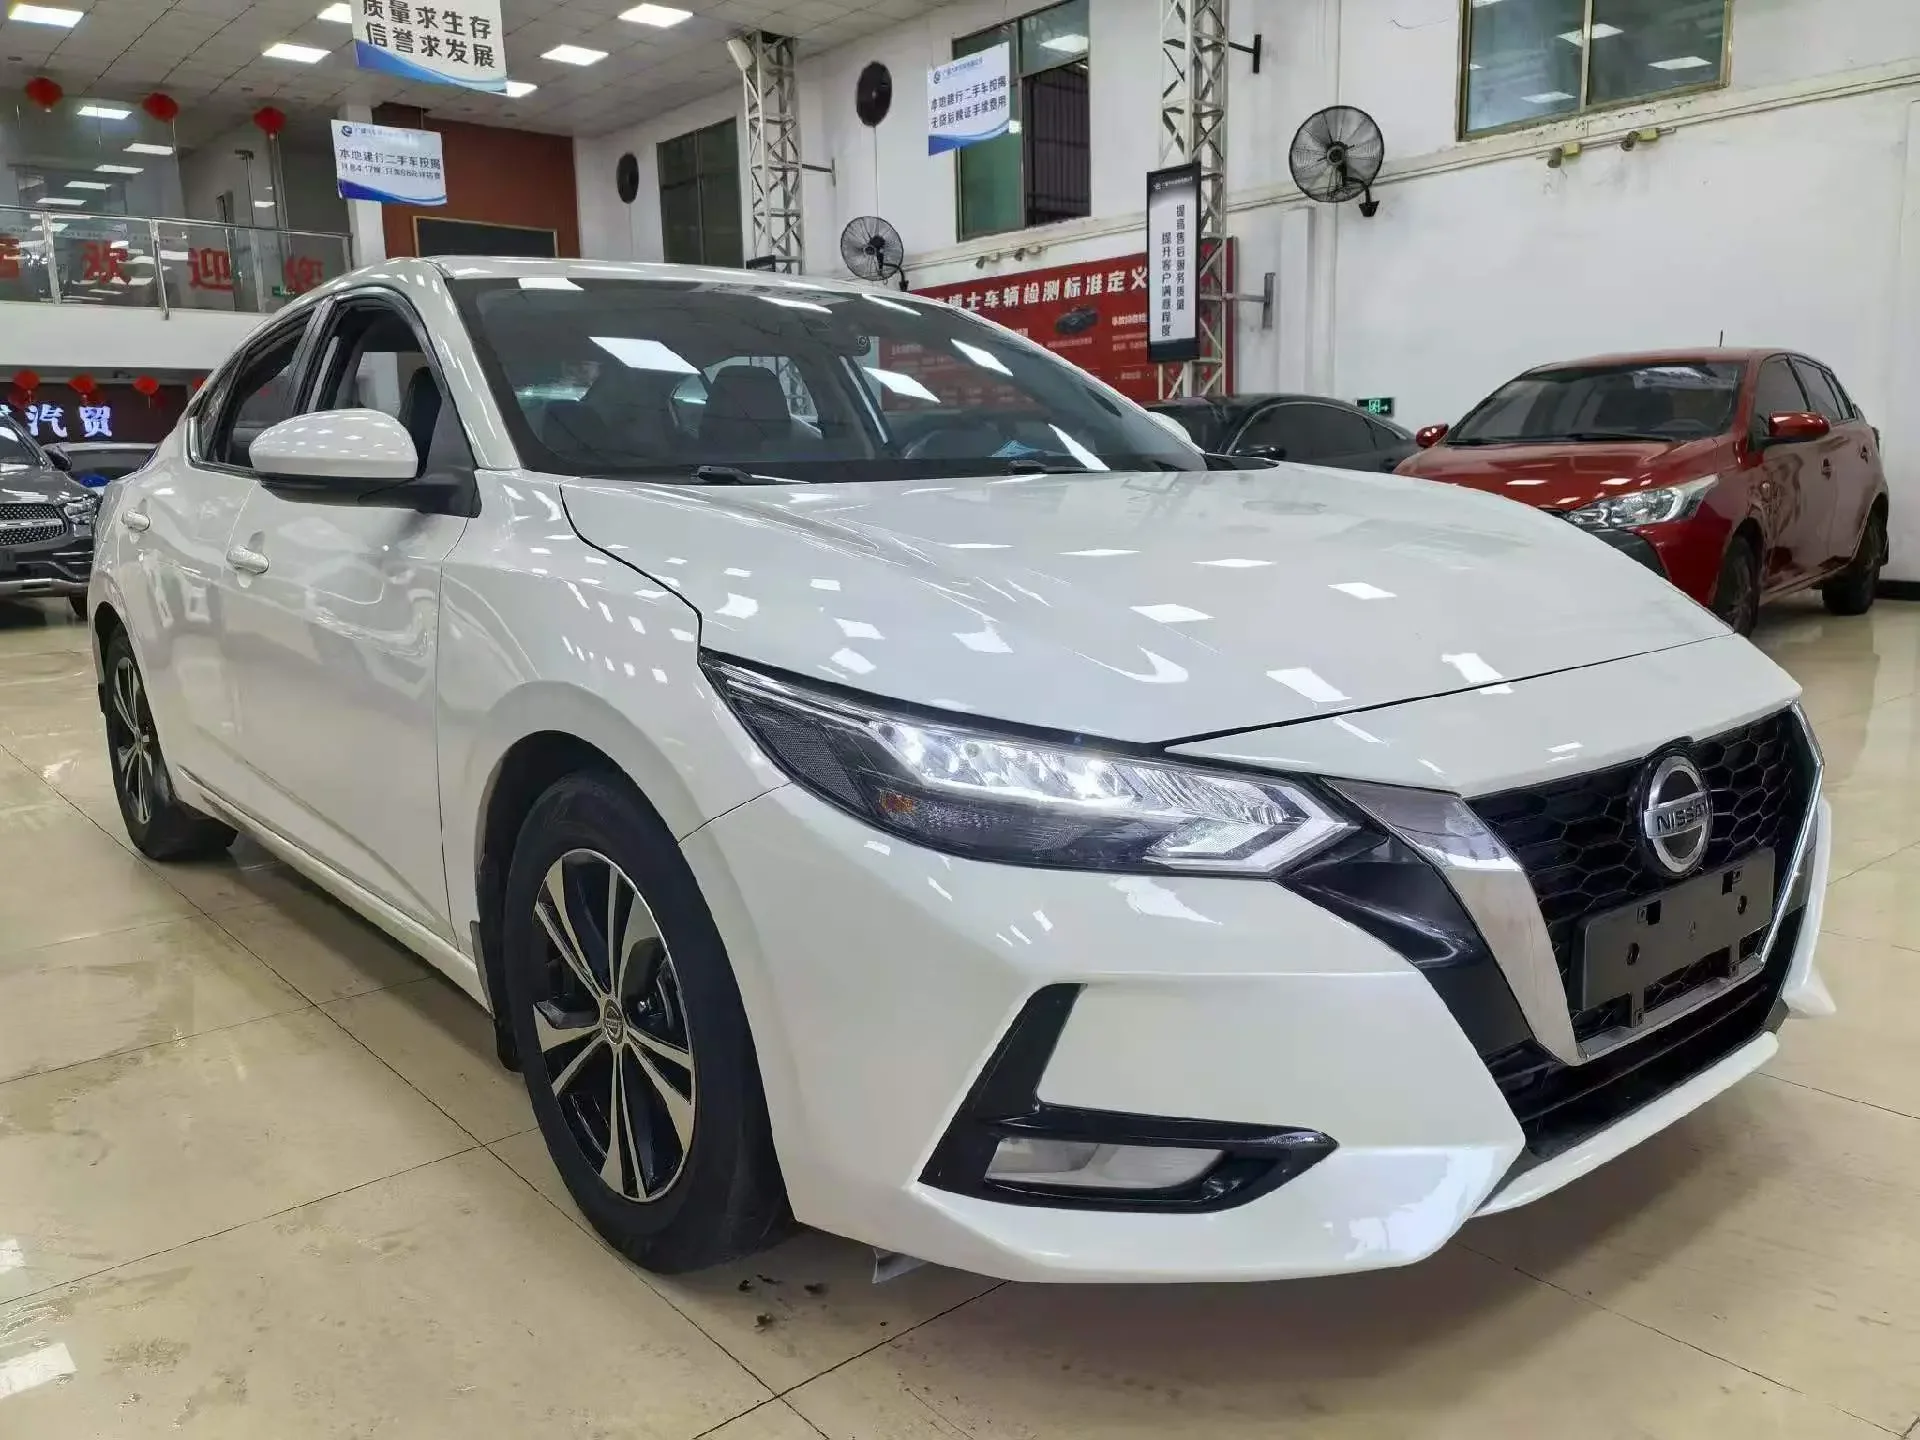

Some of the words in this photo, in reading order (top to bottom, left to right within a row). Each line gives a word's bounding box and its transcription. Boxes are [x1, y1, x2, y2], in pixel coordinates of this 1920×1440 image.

[363, 0, 491, 39] 质量求生存
[366, 22, 495, 68] 信誉求发展
[935, 265, 1147, 312] 博士车辆检测标准定义
[1656, 802, 1706, 833] NISSAN
